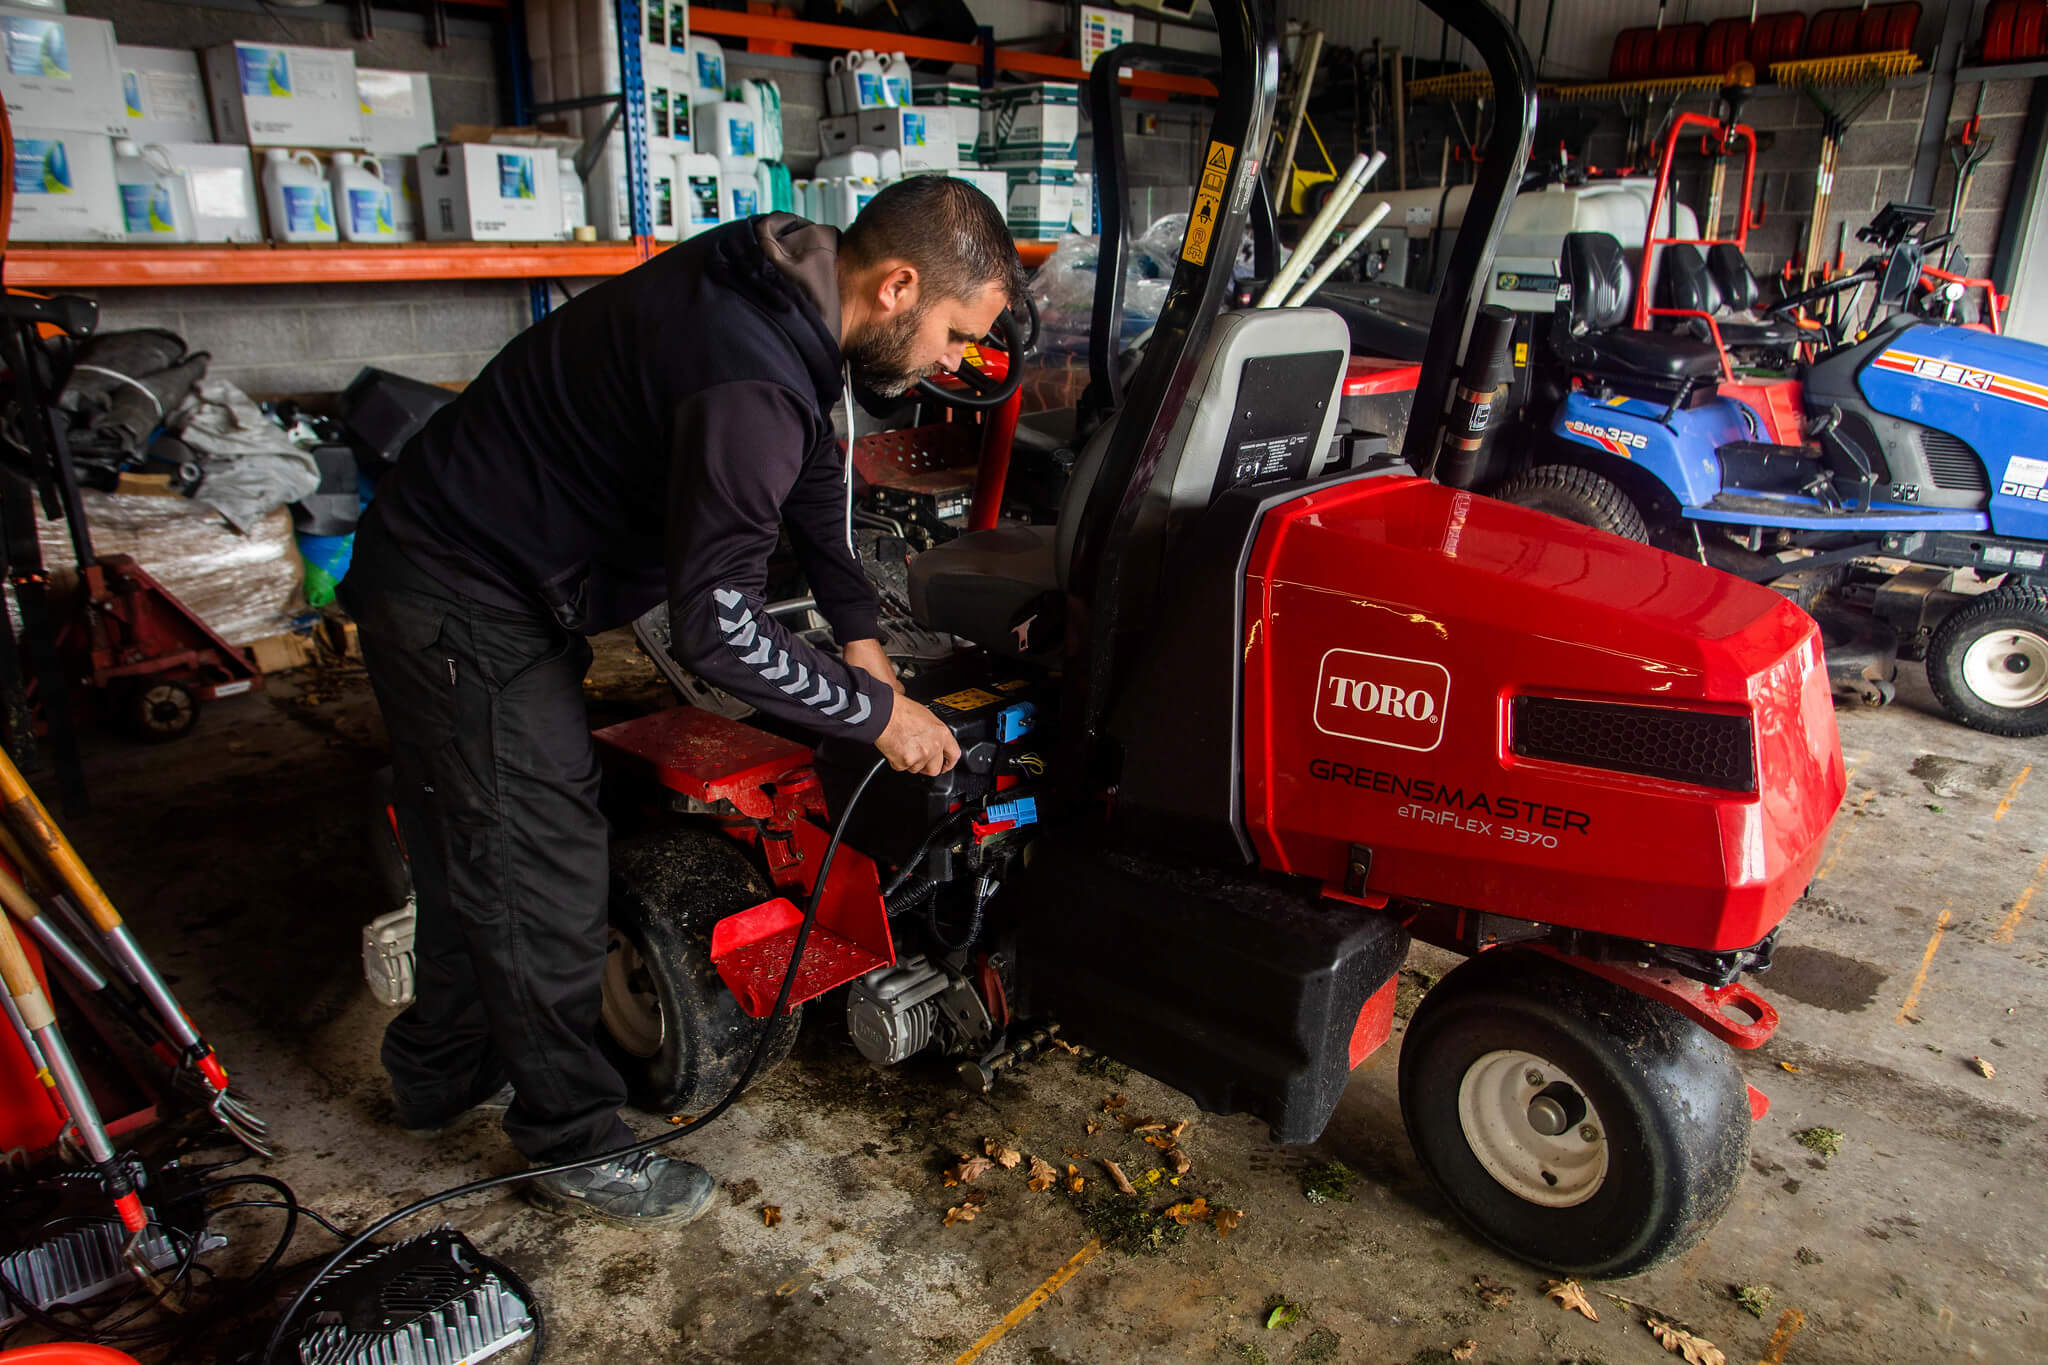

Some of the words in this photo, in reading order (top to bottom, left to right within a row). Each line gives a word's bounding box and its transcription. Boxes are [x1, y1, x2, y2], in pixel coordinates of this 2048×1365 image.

[1913, 359, 1995, 391] ISEKI
[1605, 426, 1649, 450] 326
[1328, 675, 1435, 721] TORO
[1309, 759, 1591, 835] GREENSMASTER
[1499, 825, 1558, 849] 3370
